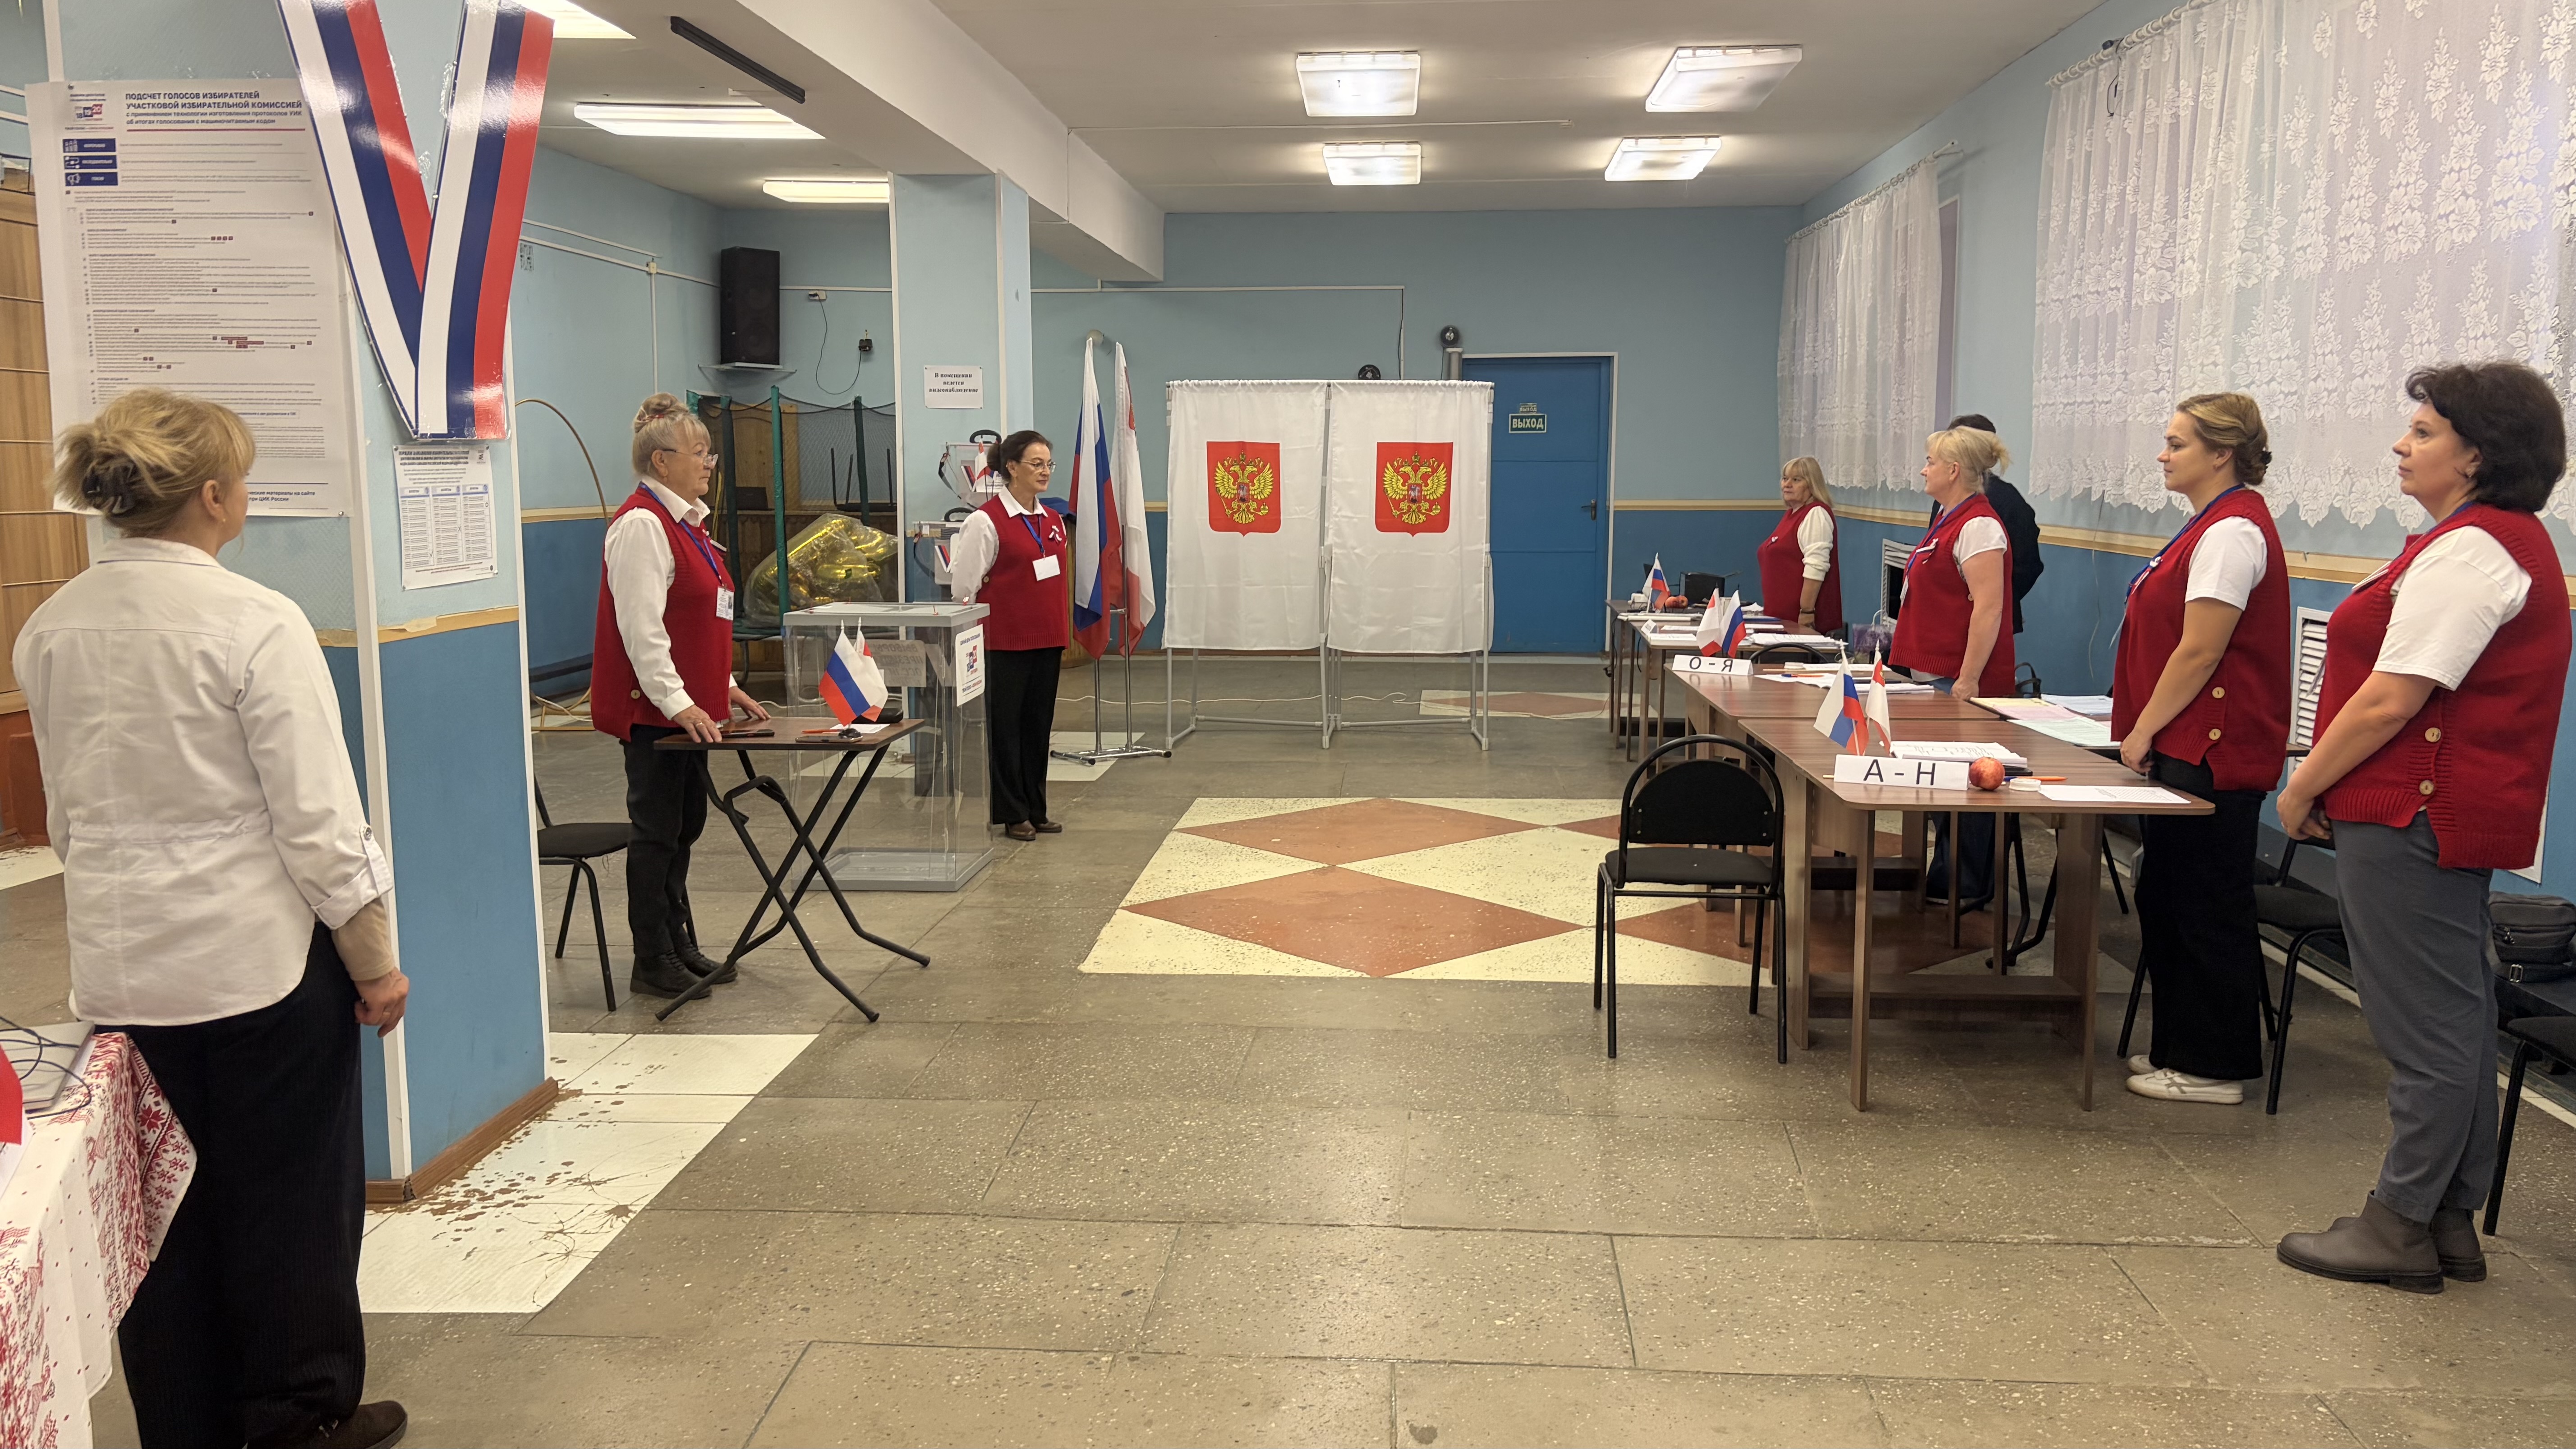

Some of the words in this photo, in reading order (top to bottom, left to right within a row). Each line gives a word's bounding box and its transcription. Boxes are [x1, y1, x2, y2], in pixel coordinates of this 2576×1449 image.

[202, 90, 259, 99] ИЗБИРАТЕЛЕЙ
[126, 101, 179, 109] УЧАСТКОВОЙ
[181, 100, 249, 109] ИЗБИРАТЕЛЬНОЙ
[251, 100, 302, 108] КОМИССИЕЙ
[1512, 418, 1544, 430] ВЫХОД
[1689, 656, 1702, 670] О
[1721, 659, 1733, 672] Я
[1863, 759, 1884, 782] А
[1916, 762, 1936, 786] Н
